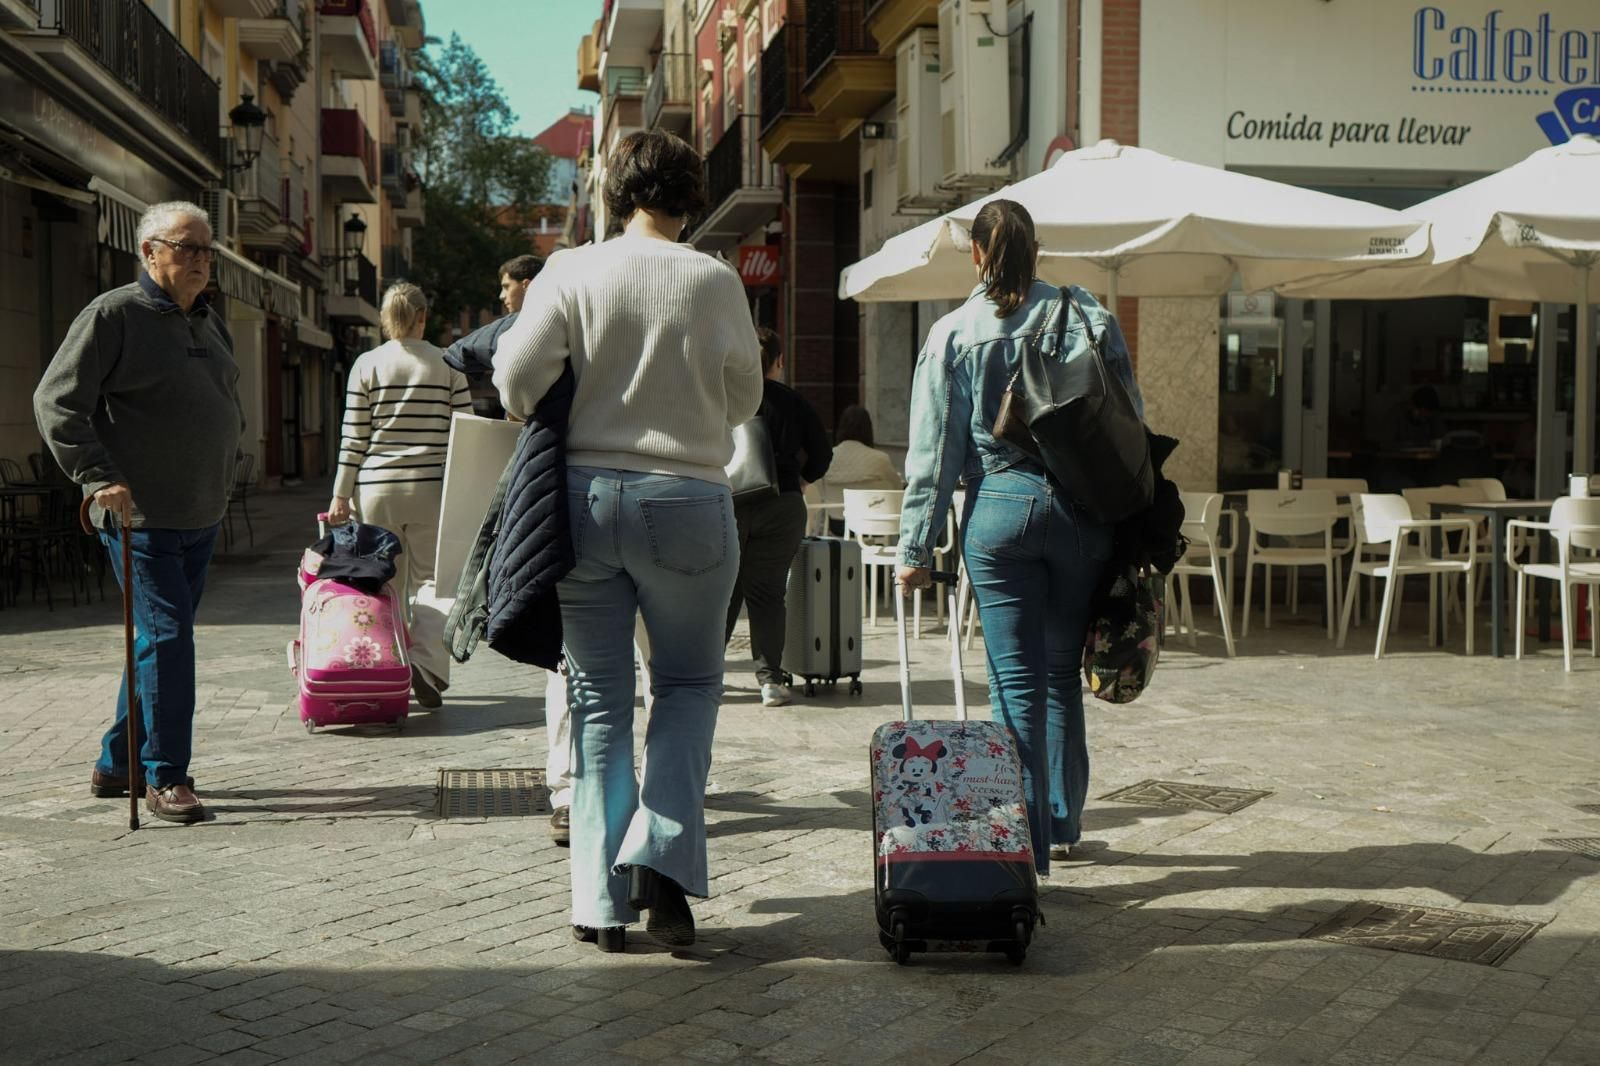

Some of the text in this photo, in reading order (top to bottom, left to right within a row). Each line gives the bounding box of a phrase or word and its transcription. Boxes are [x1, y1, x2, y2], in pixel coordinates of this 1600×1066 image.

[1227, 110, 1471, 147] Comida para llevar
[742, 250, 776, 281] illy
